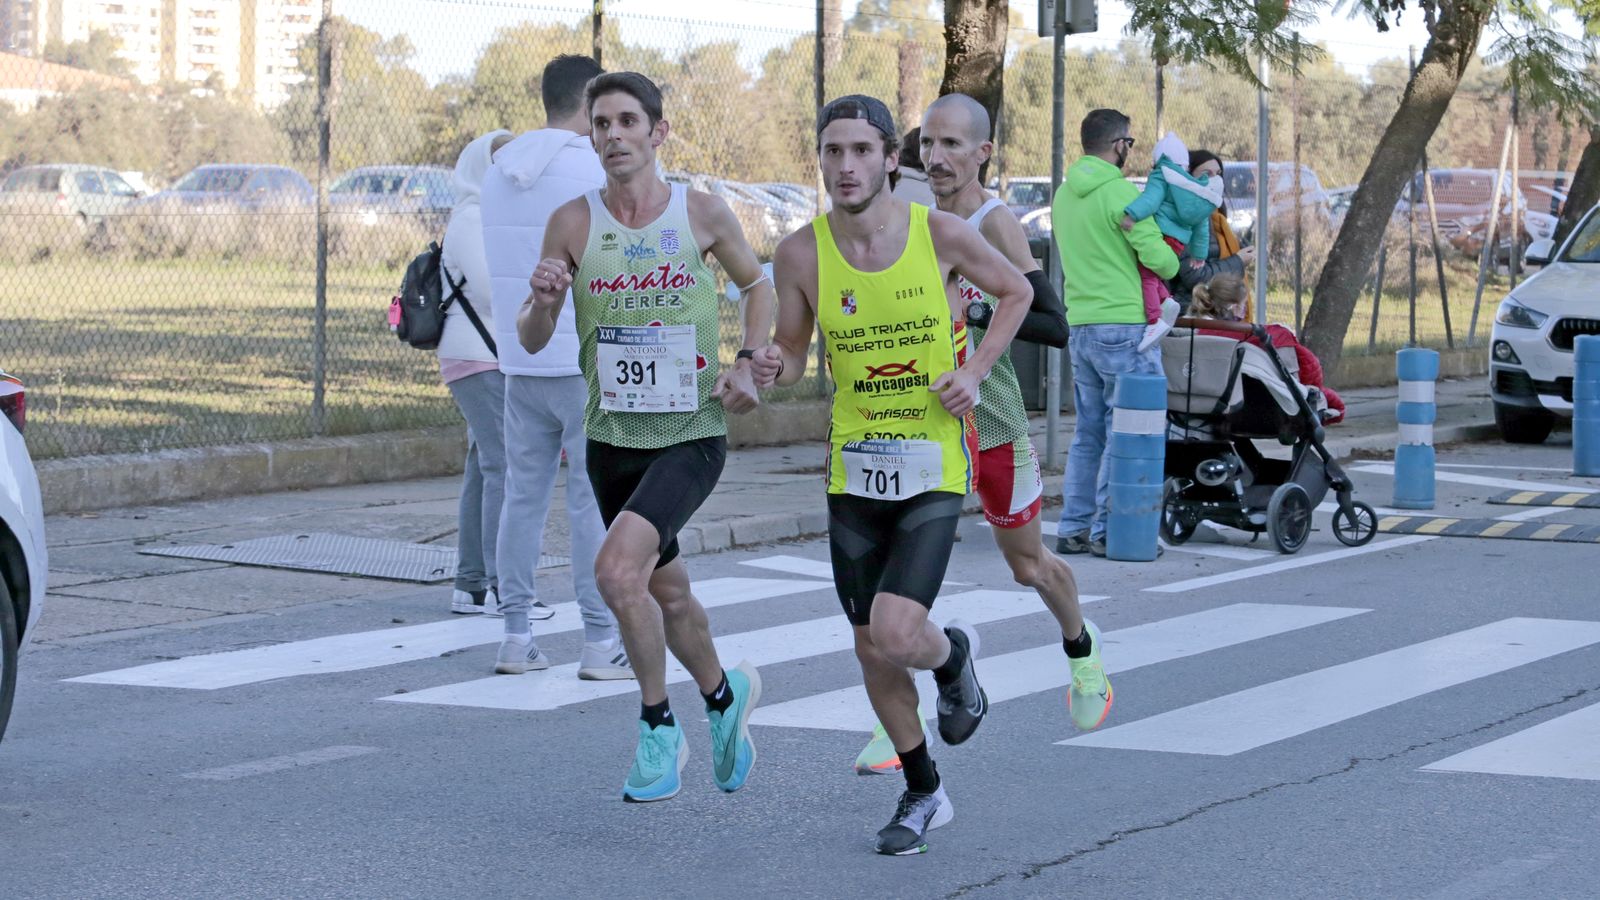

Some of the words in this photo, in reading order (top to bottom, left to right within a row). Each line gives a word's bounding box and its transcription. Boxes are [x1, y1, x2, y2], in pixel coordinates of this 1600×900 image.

[589, 262, 695, 294] maratón
[610, 295, 680, 309] JEREZ
[896, 287, 924, 300] GOBIK
[600, 329, 616, 340] XXV
[829, 328, 866, 340] CLUB
[869, 315, 940, 335] TRIATLÓN
[623, 346, 667, 354] ANTONIO
[836, 340, 894, 353] PUERTO
[899, 333, 936, 347] REAL
[616, 359, 656, 385] 391
[871, 455, 906, 464] DANIEL
[862, 468, 900, 496] 701
